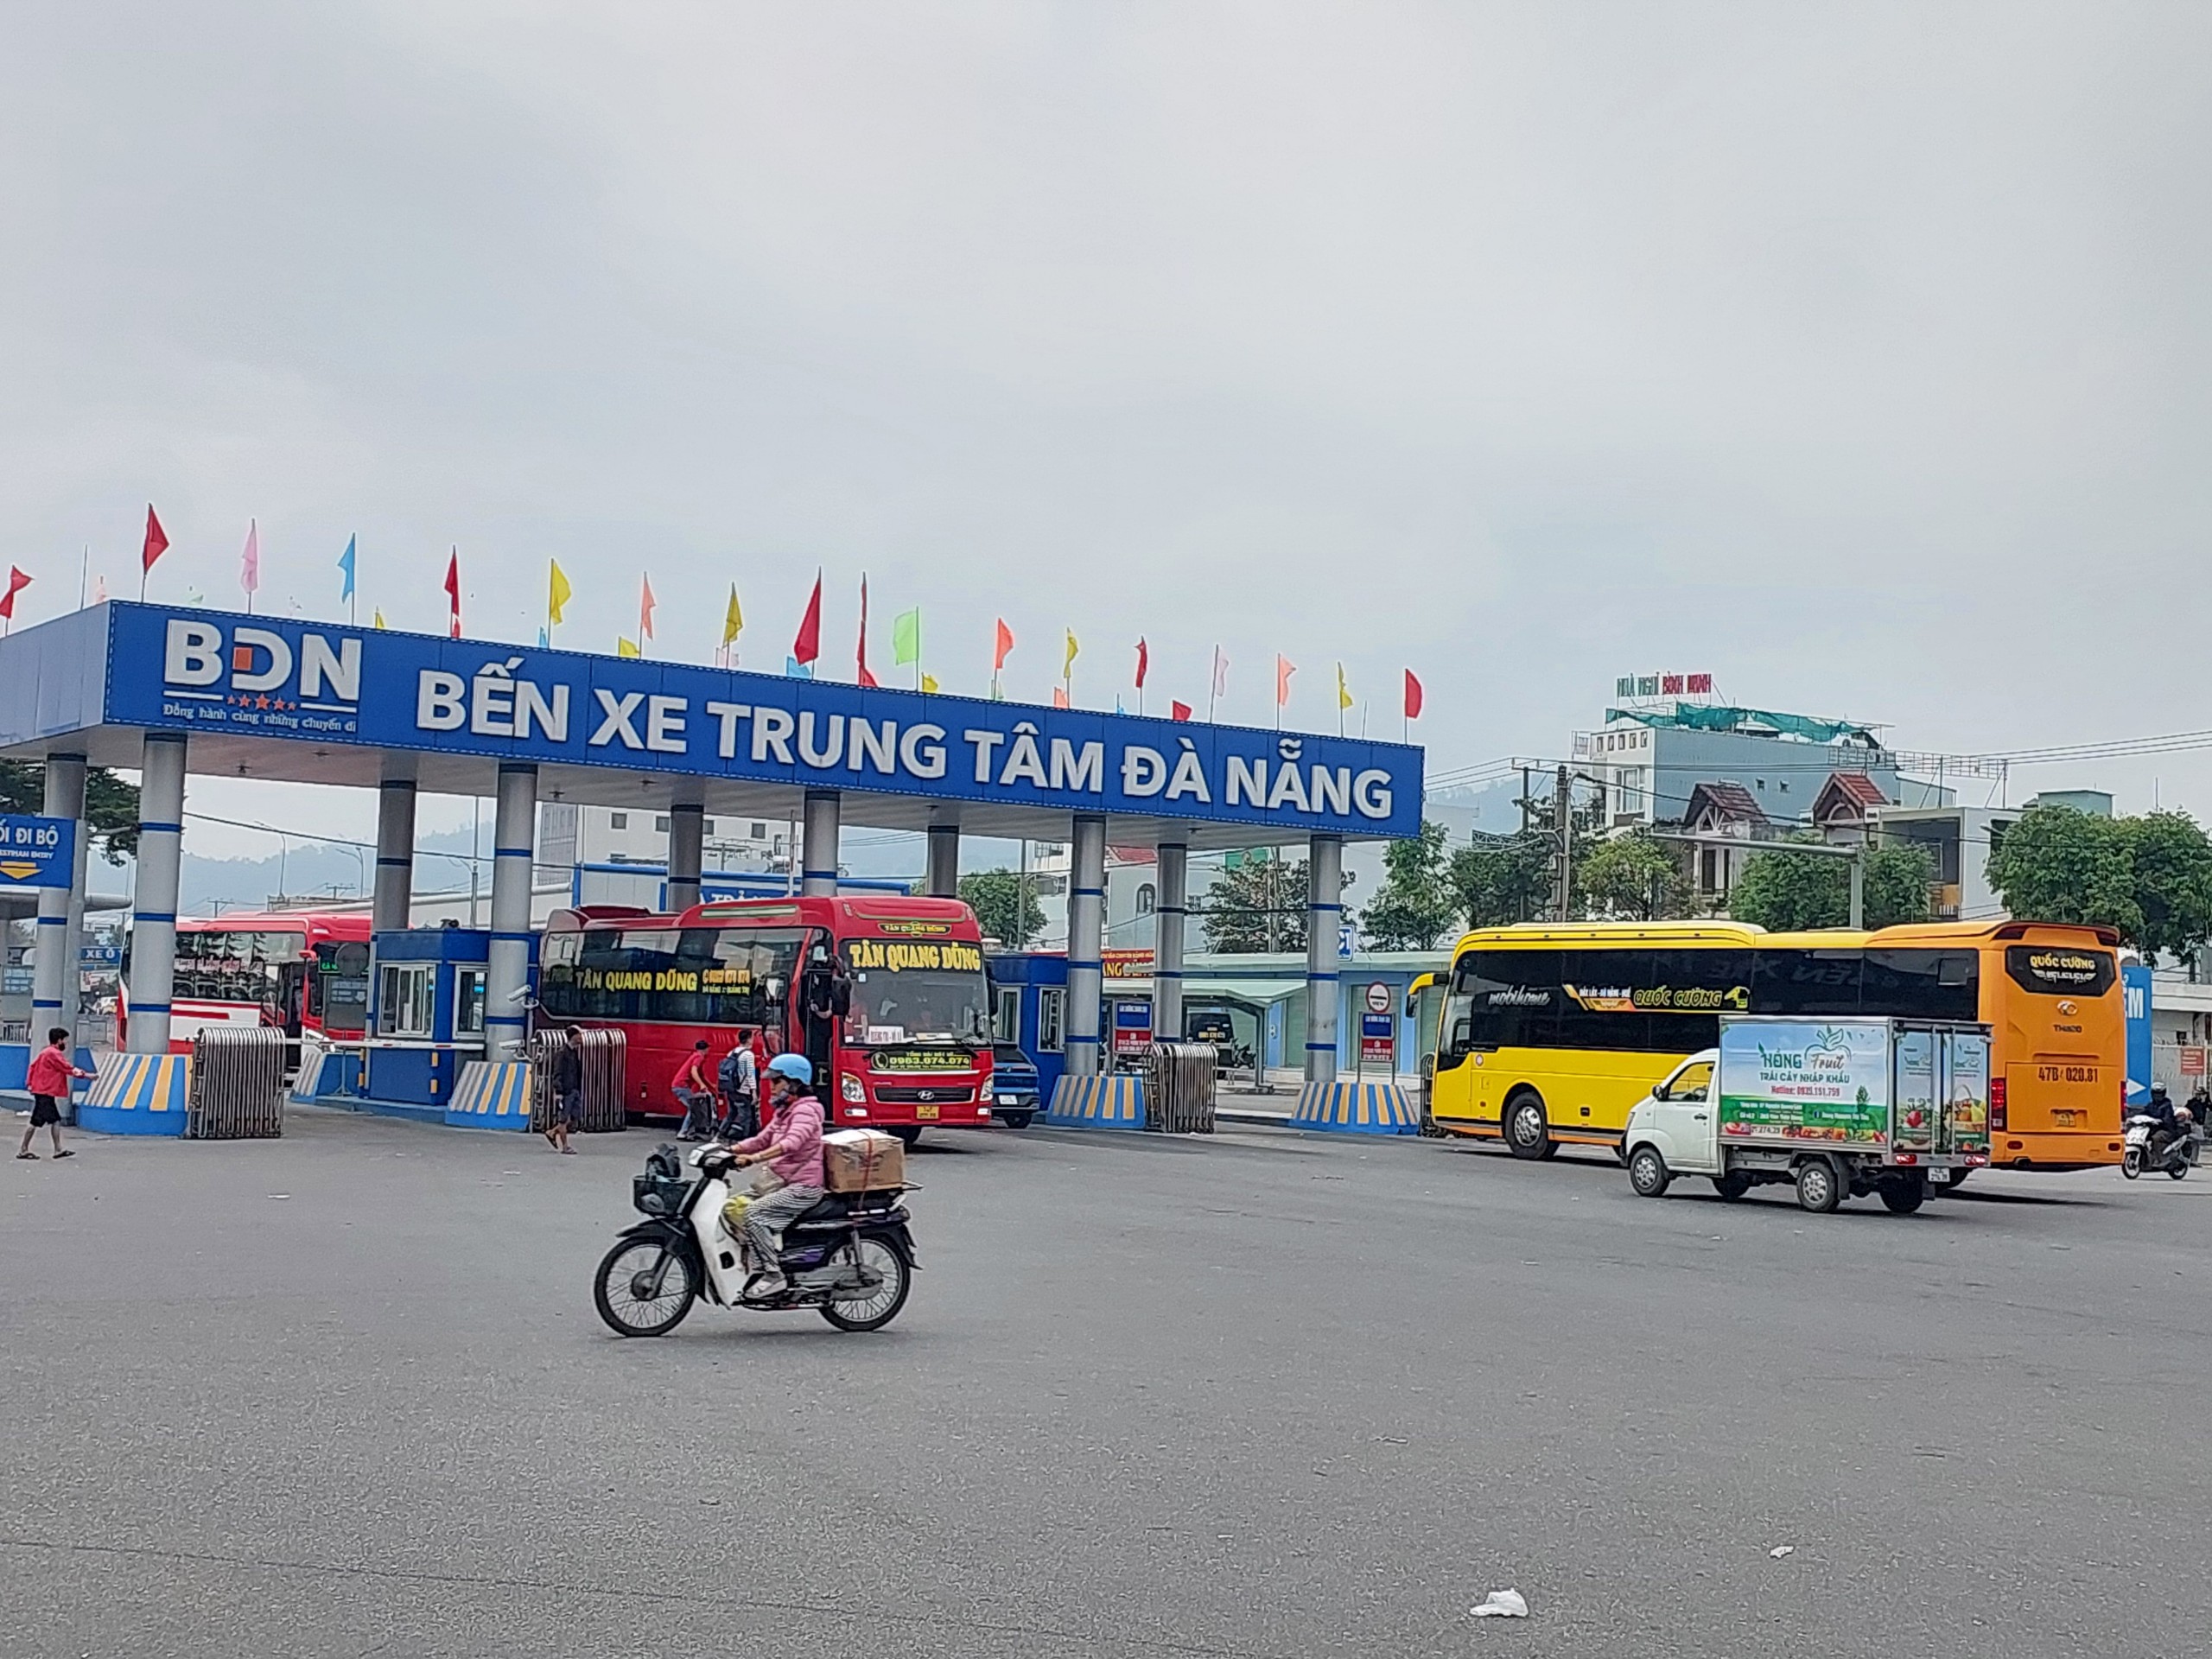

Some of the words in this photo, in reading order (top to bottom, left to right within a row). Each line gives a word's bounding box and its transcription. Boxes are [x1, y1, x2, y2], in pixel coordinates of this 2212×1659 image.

[198, 707, 226, 721] hành
[302, 717, 341, 731] chuyến
[416, 657, 569, 741] BẾN
[588, 689, 688, 753] XE
[707, 702, 946, 778] TRUNG
[963, 722, 1104, 792] TÂM
[1121, 737, 1211, 803] ĐÀ
[1226, 738, 1392, 818] NẴNG
[16, 827, 32, 844] ĐI
[35, 825, 59, 849] BỘ
[86, 949, 103, 959] XE
[849, 939, 885, 968] TÂN
[886, 944, 940, 972] QUANG
[941, 942, 981, 970] DŨNG
[2030, 952, 2059, 968] QUỐC
[575, 968, 602, 989] TÂN
[605, 970, 652, 992] QUANG
[655, 968, 698, 992] DŨNG
[1811, 1052, 1845, 1070] Fruit
